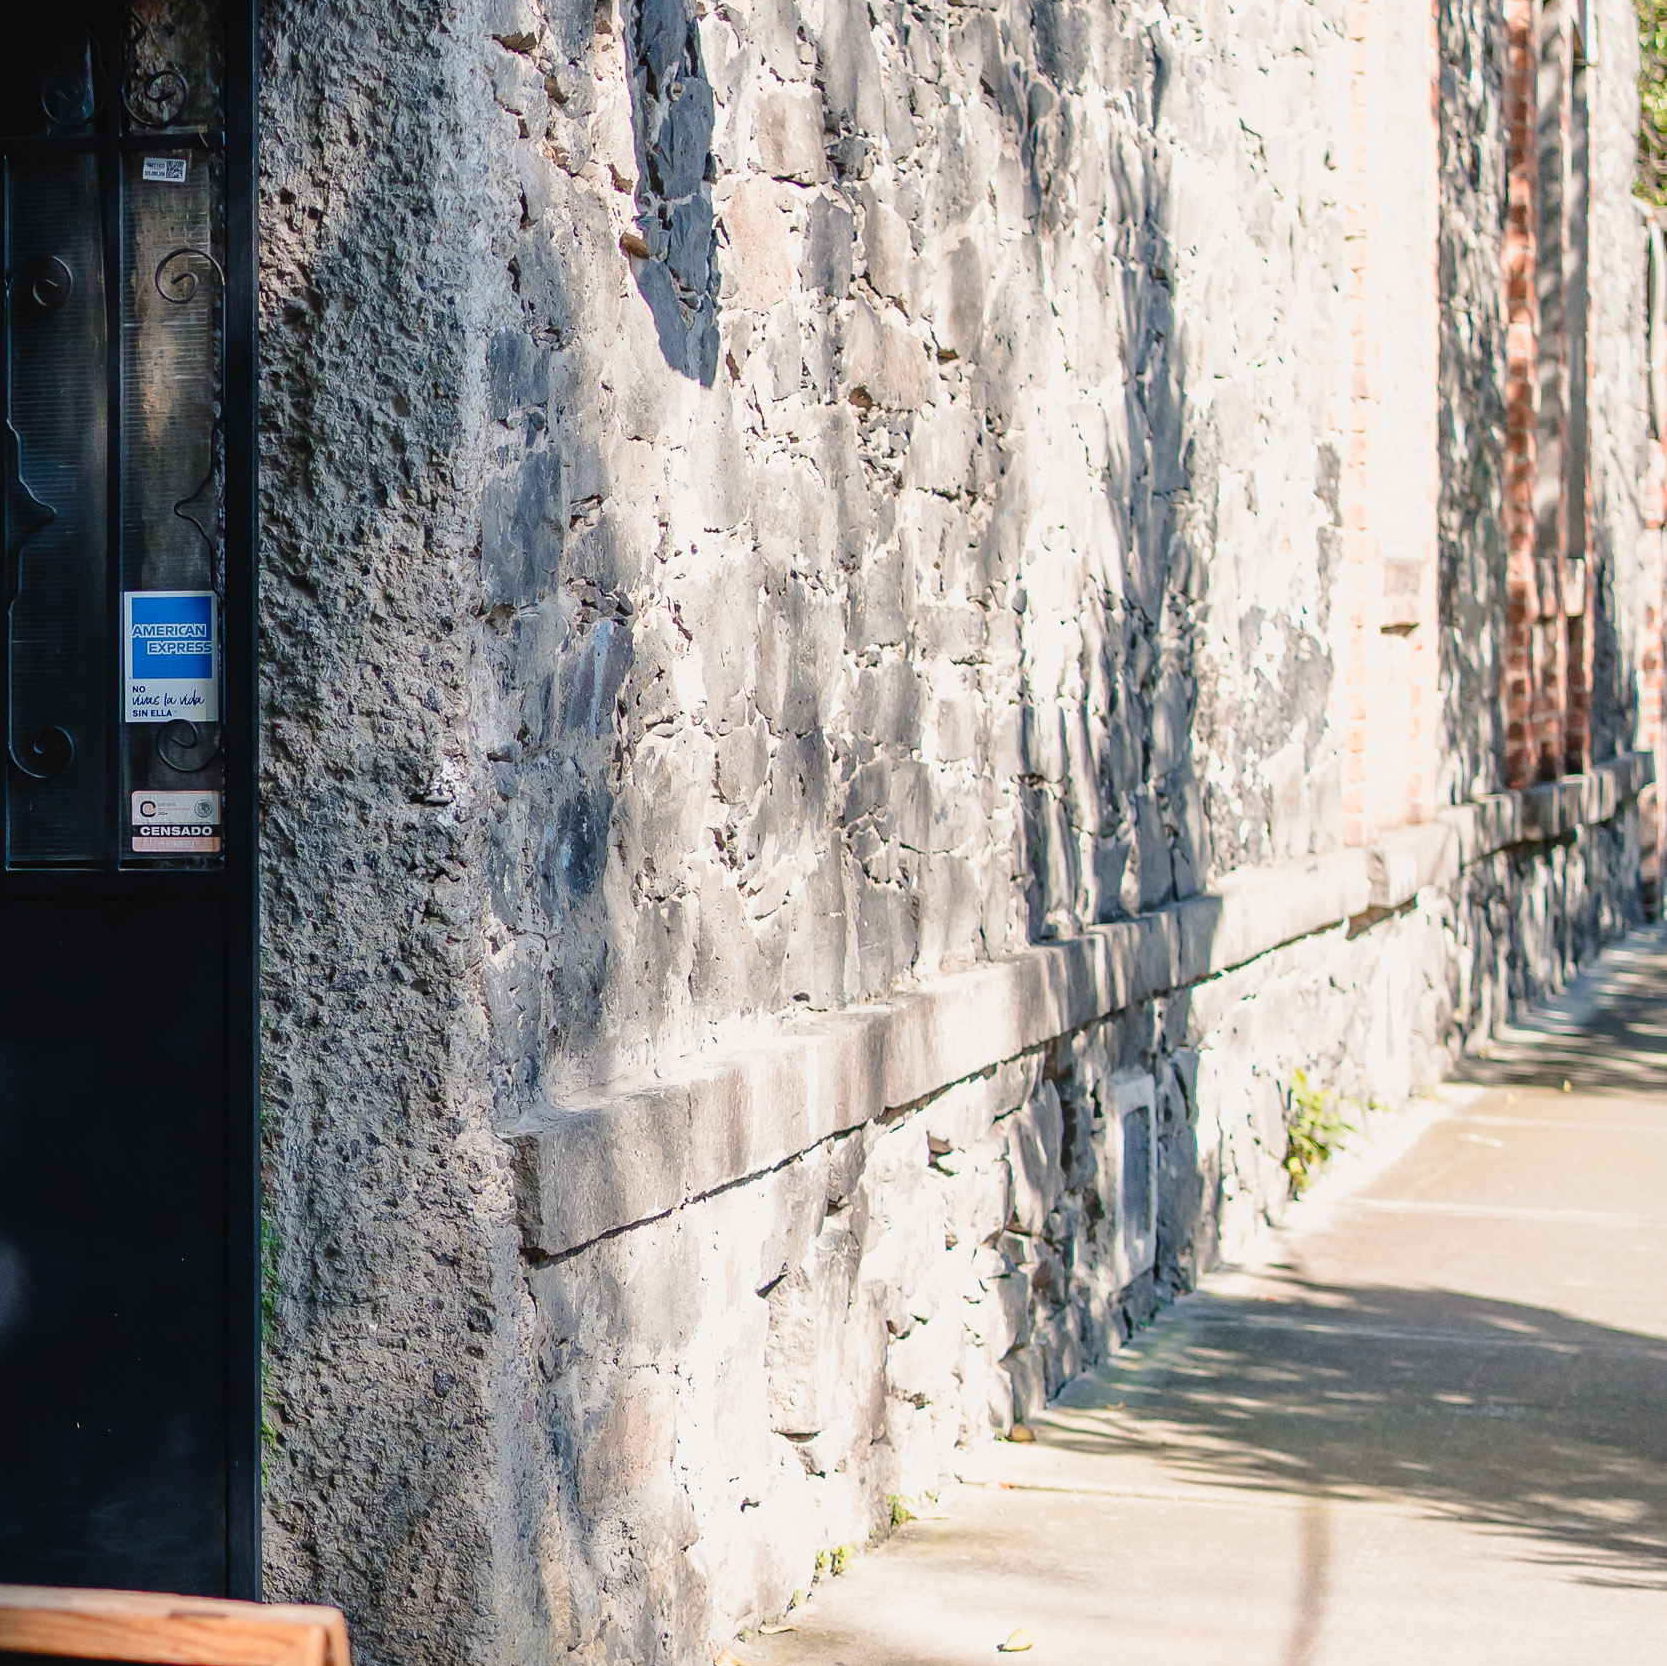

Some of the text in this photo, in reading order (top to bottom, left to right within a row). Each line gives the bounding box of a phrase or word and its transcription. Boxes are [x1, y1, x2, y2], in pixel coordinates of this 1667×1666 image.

[132, 624, 206, 637] AMERICAN
[147, 641, 213, 654] EXPRESS
[132, 685, 146, 693] NO
[132, 689, 205, 706] vivas la vida
[132, 709, 173, 717] SIN ELLA
[140, 826, 213, 836] CENSADO
